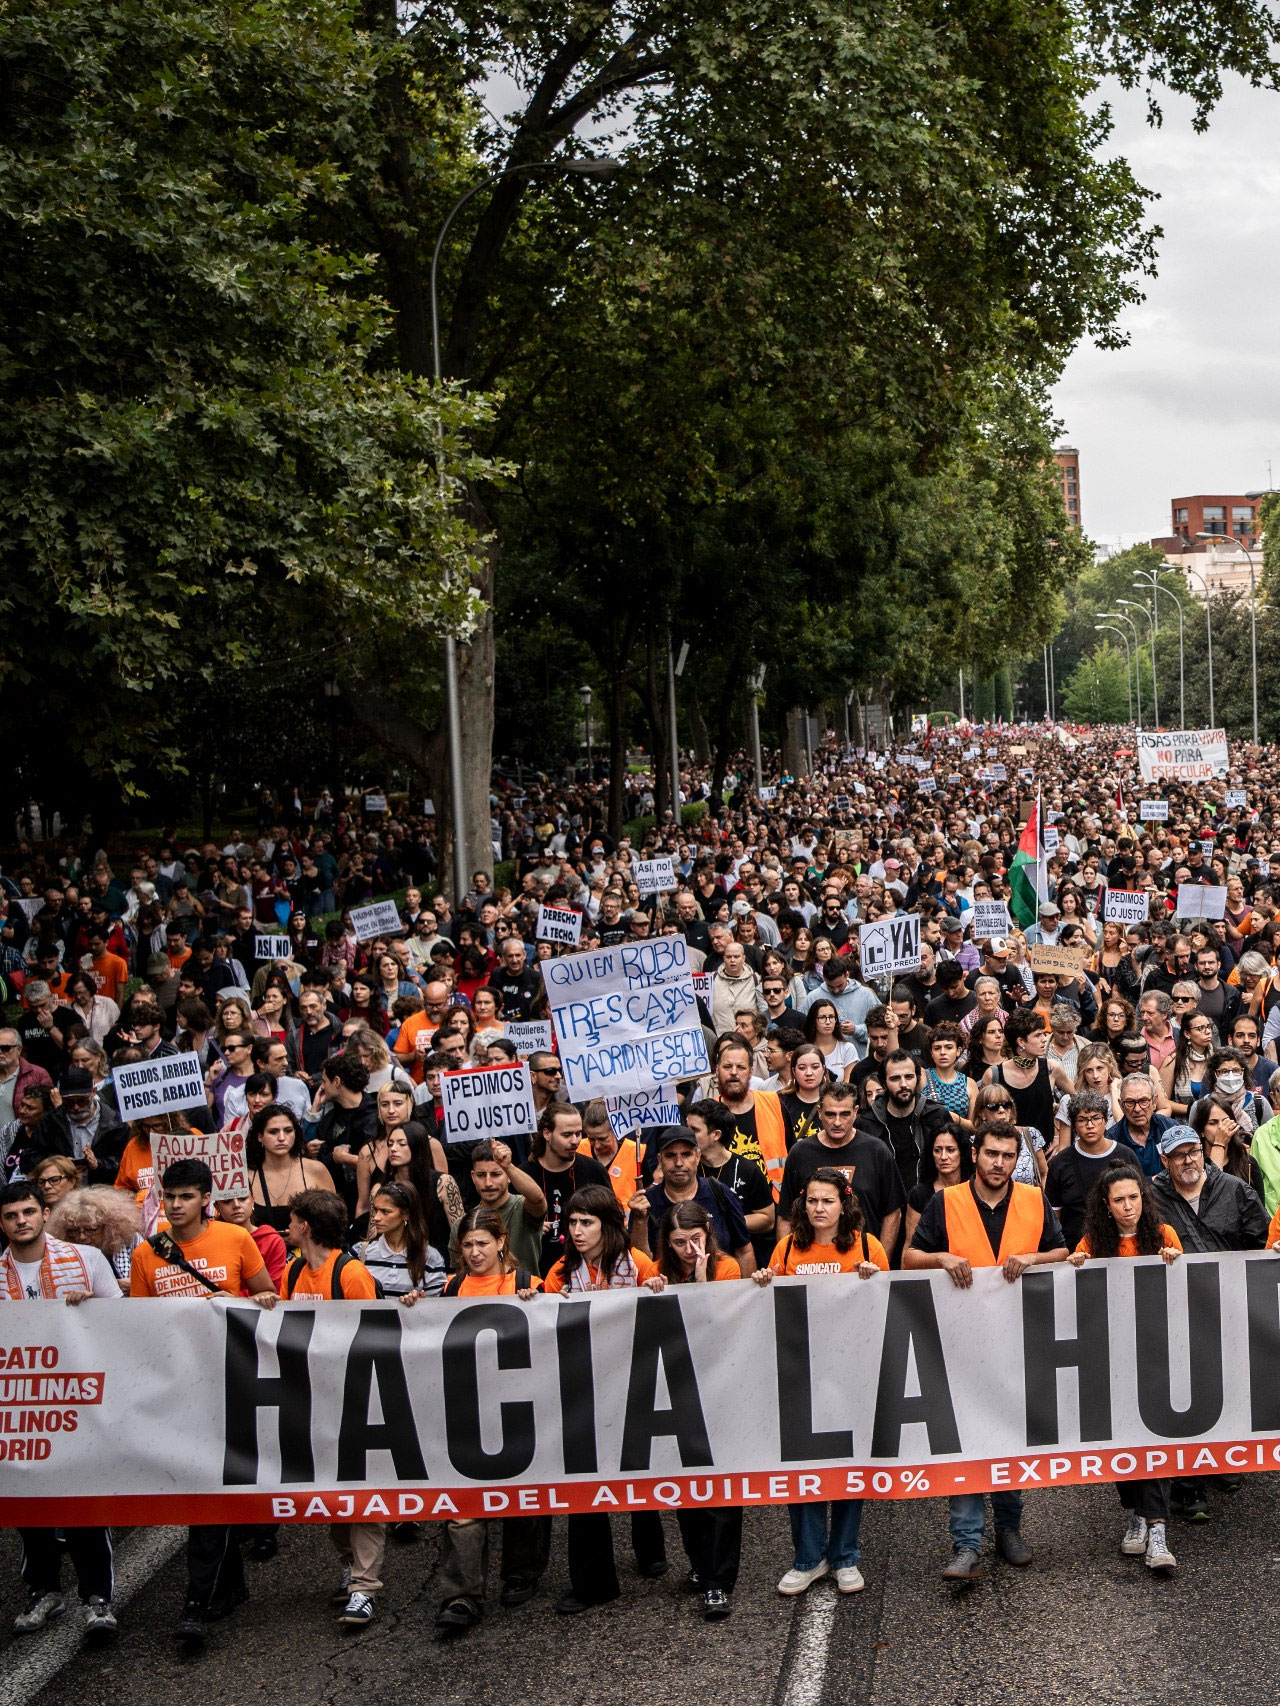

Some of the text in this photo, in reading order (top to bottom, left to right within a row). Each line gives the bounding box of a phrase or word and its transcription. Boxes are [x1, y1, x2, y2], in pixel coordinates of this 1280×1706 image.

[1172, 734, 1199, 747] PARA
[1198, 730, 1226, 746] VIVIR
[1157, 748, 1203, 763] NO PARA
[1151, 763, 1213, 779] ESPECULAR
[656, 860, 671, 872] no!
[1108, 892, 1144, 905] ¡PEDIMOS
[543, 909, 577, 925] DERECHO
[1106, 907, 1146, 920] LO JUSTO!
[543, 926, 576, 942] A TECHO.
[890, 919, 919, 960] YA!
[257, 936, 289, 958] ASÍ, NO
[550, 940, 686, 986] QUIEN ROBO
[870, 962, 892, 973] JUSTO
[895, 957, 920, 968] PRECIO
[552, 983, 695, 1040] TRES CASAS
[647, 1011, 684, 1034] EN
[508, 1025, 547, 1036] Alquileres,
[585, 1032, 601, 1048] 3
[535, 1038, 548, 1048] YA.
[119, 1061, 198, 1090] SUELDOS, ARRIBA!
[565, 1043, 636, 1087] MADRID
[651, 1056, 708, 1081] SOLO
[124, 1081, 202, 1111] PISOS, ABAJO!
[446, 1069, 524, 1106] ¡PEDIMOS
[606, 1084, 669, 1113] UNO 1
[447, 1101, 532, 1133] LO JUSTO!
[610, 1106, 655, 1139] PARA
[156, 1133, 244, 1156] AQUI NO
[796, 1262, 841, 1275] SINDICATO
[157, 1281, 169, 1292] DE
[223, 1295, 715, 1486] HACIA
[774, 1278, 963, 1463] LA
[272, 1493, 459, 1518] BAJADA
[483, 1488, 569, 1512] DEL
[592, 1475, 822, 1508] ALQUILER
[845, 1470, 930, 1493] 50%
